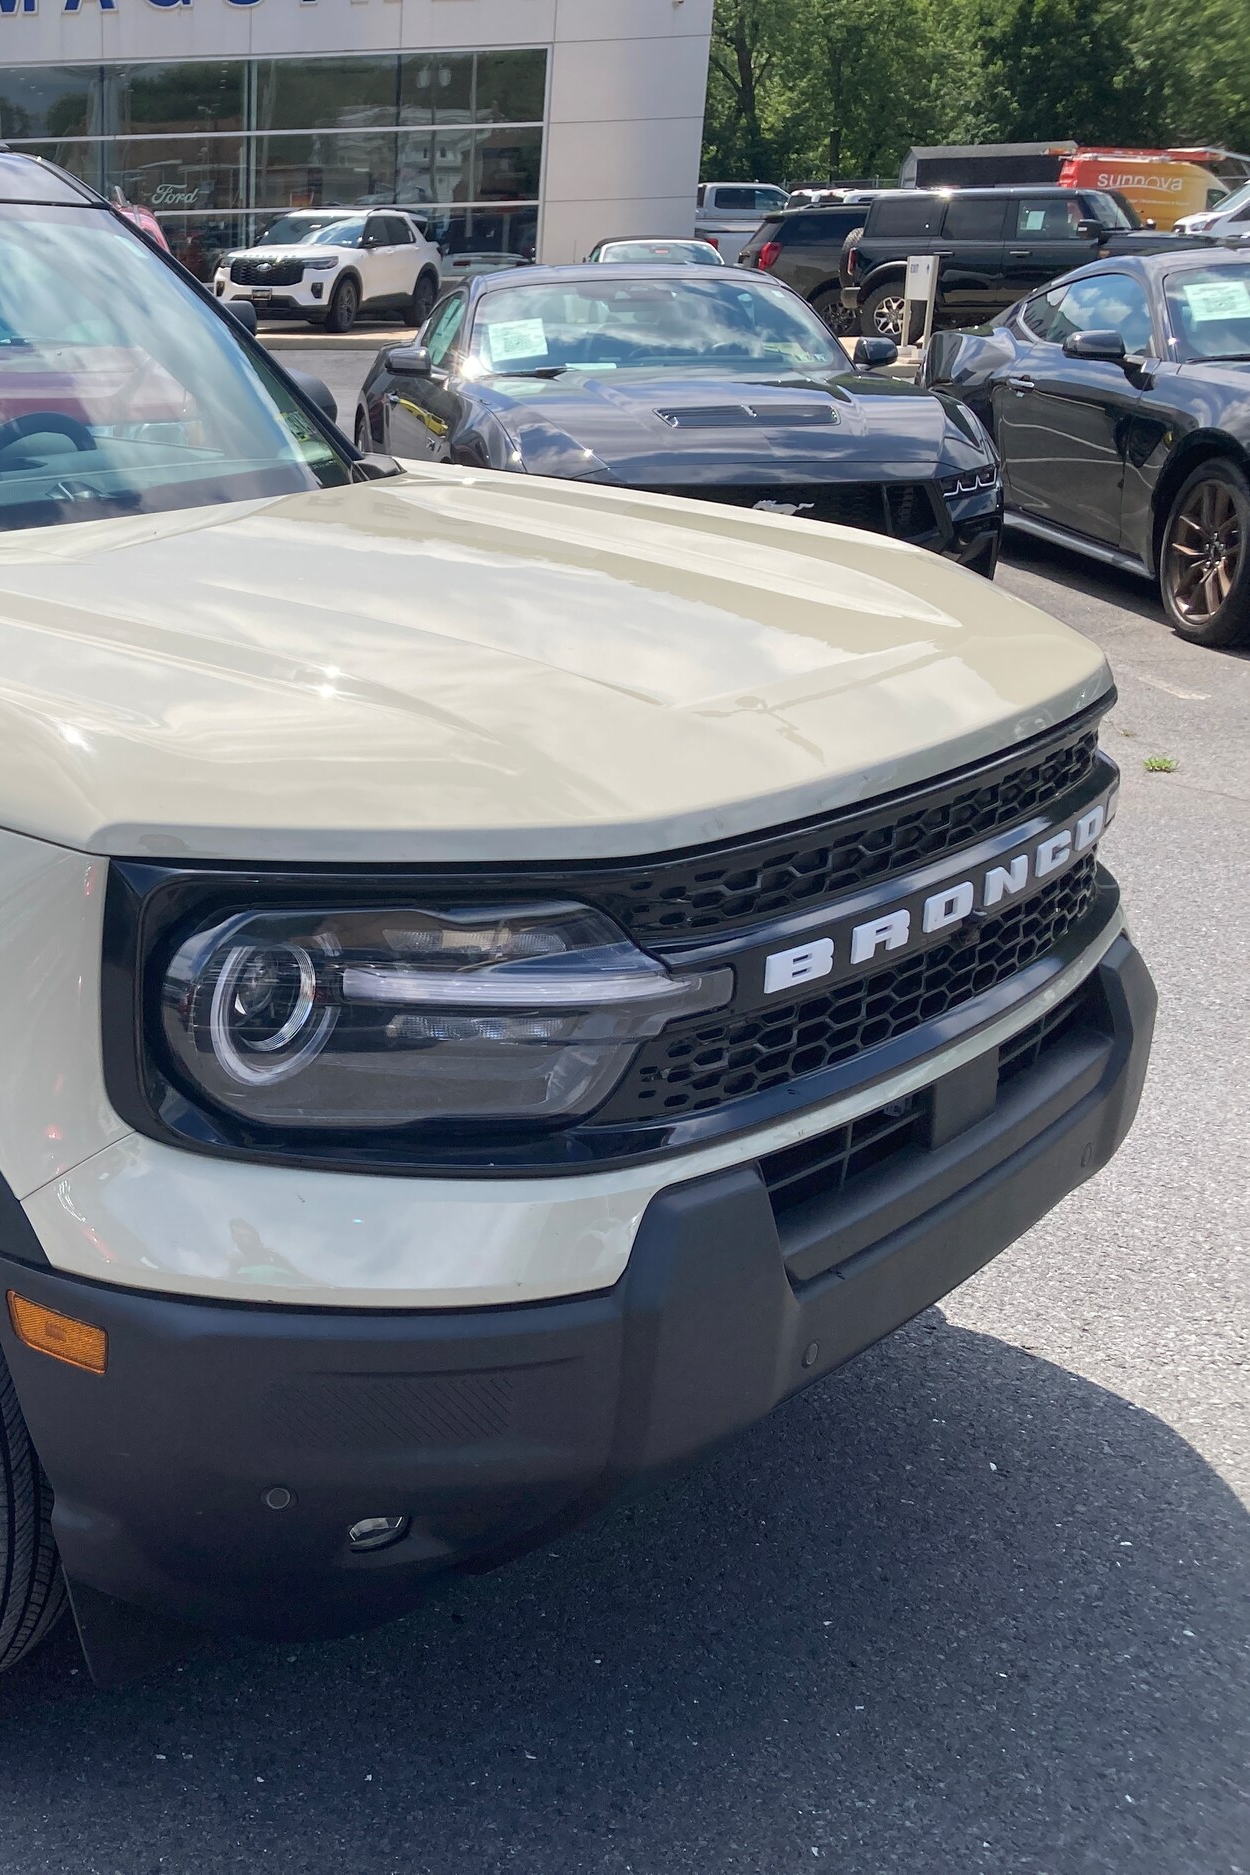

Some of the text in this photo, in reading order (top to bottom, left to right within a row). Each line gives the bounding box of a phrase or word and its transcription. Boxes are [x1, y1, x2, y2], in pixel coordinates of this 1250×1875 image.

[1096, 173, 1183, 192] sunnova
[151, 183, 199, 204] Ford
[763, 804, 1104, 995] BRONCO
